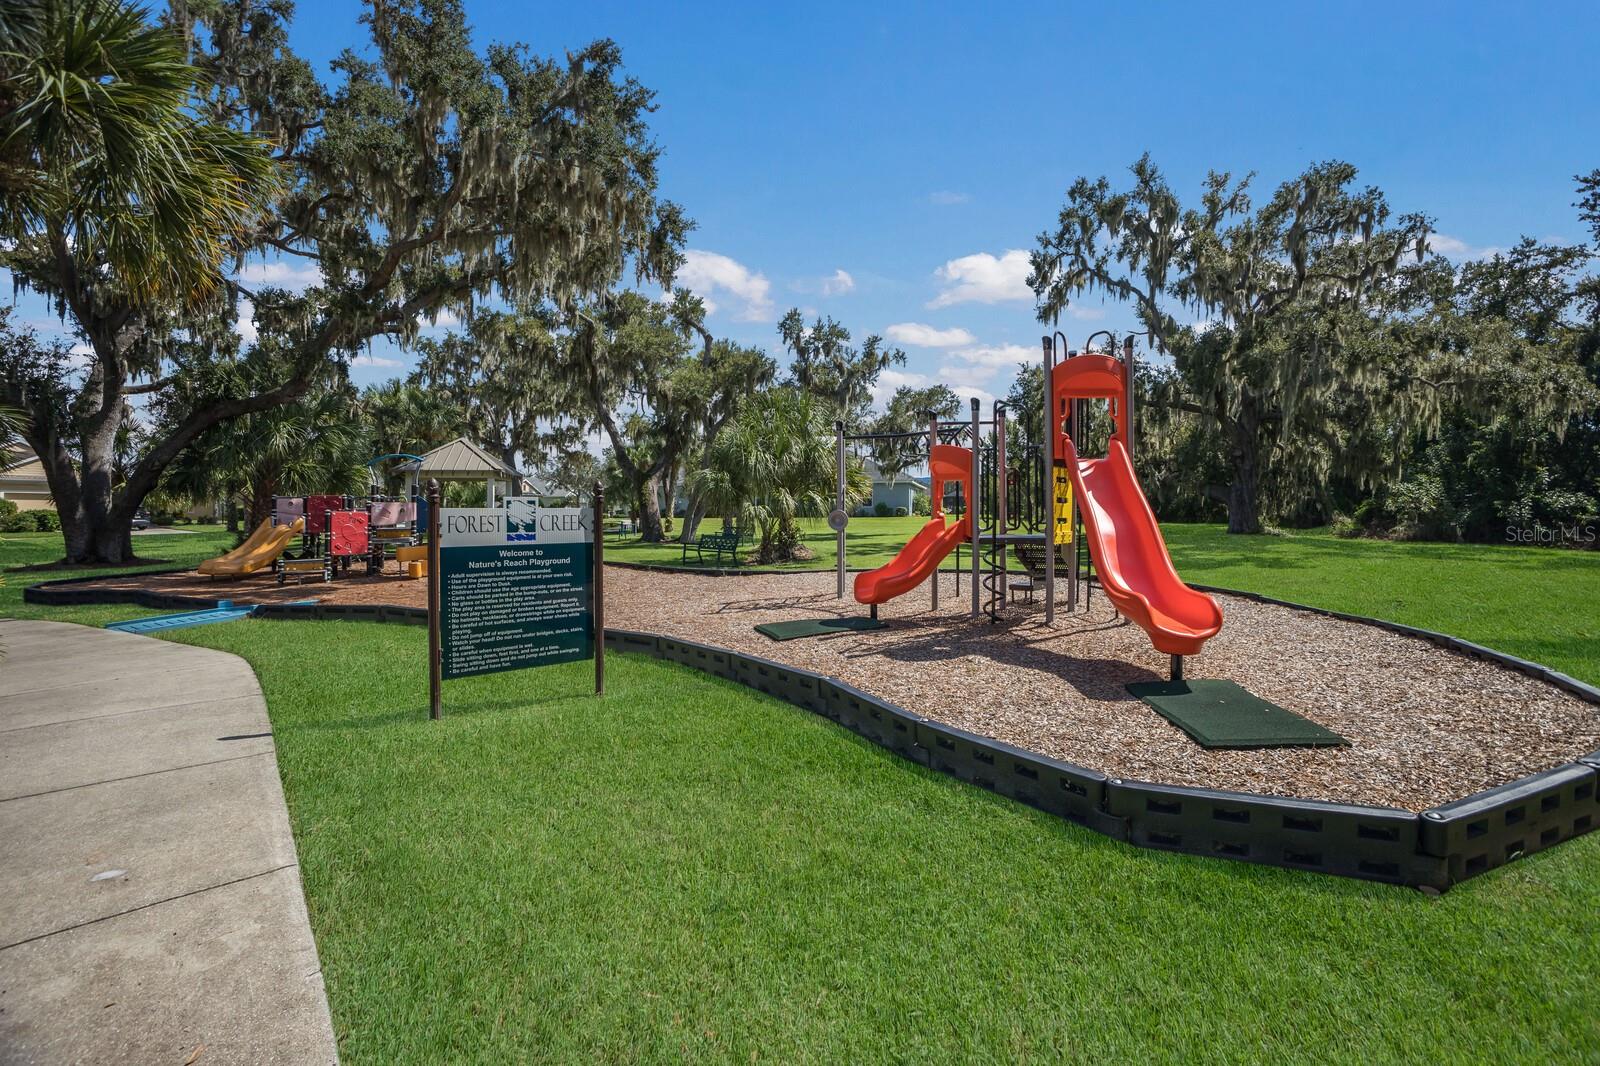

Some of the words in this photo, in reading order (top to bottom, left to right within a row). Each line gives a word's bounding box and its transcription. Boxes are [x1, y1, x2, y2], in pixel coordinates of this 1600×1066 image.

[448, 515, 503, 534] FOREST
[540, 514, 588, 532] CREEK
[468, 560, 502, 568] Nature's
[503, 558, 528, 566] Reach
[529, 556, 570, 566] Playground
